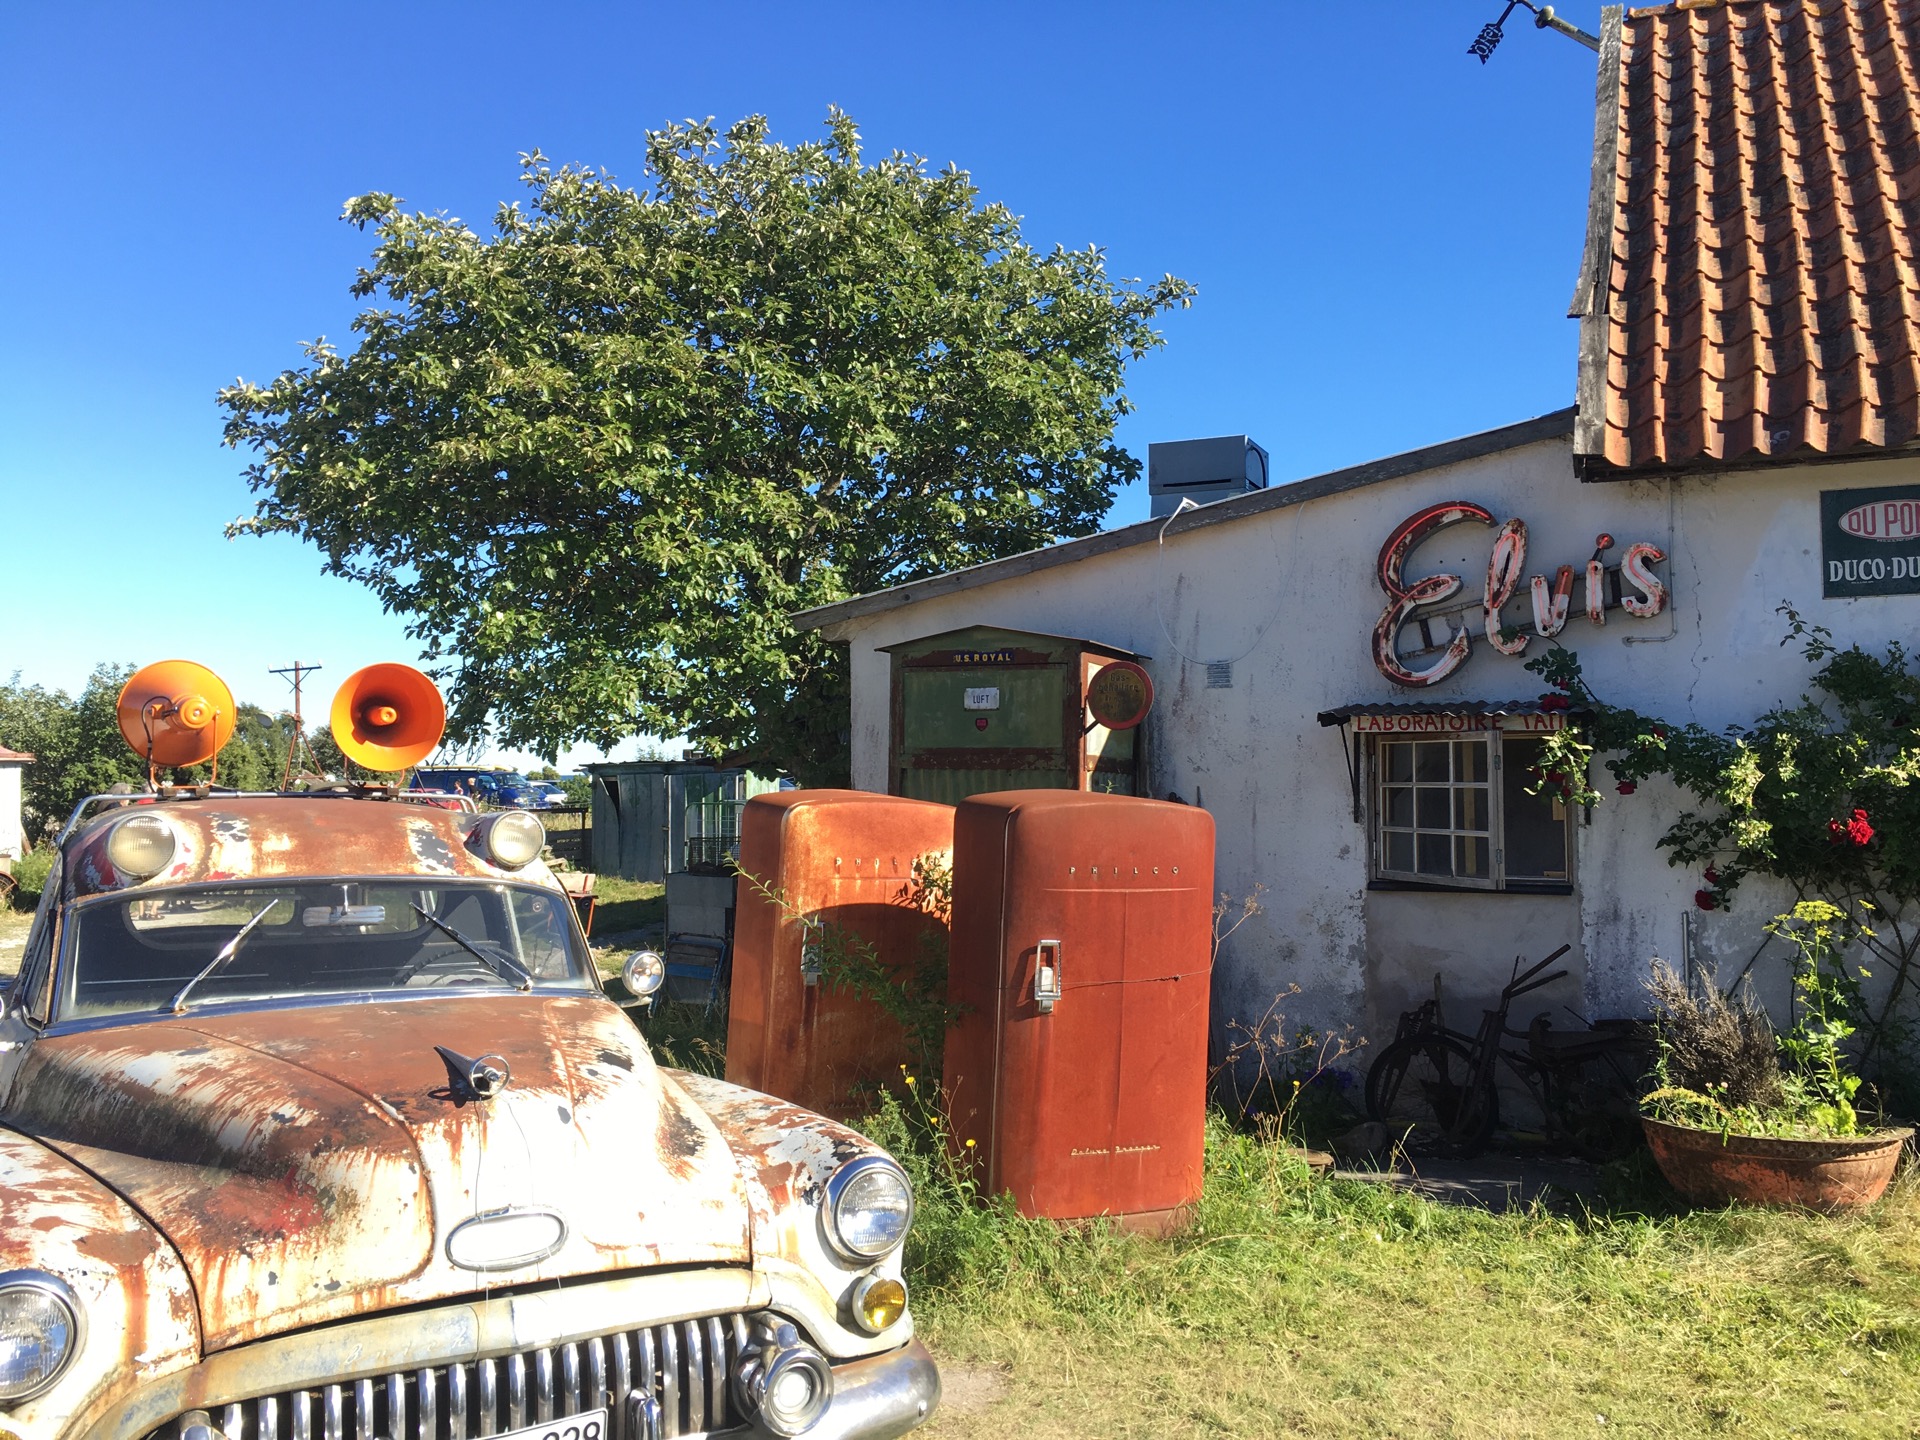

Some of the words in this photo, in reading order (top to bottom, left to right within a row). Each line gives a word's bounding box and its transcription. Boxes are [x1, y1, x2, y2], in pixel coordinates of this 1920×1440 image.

[1371, 500, 1669, 688] Elvis
[974, 653, 1011, 662] ROYAL
[973, 694, 990, 704] LUFT
[1357, 715, 1504, 731] LABORATOIRE
[1069, 866, 1179, 875] PHILCO
